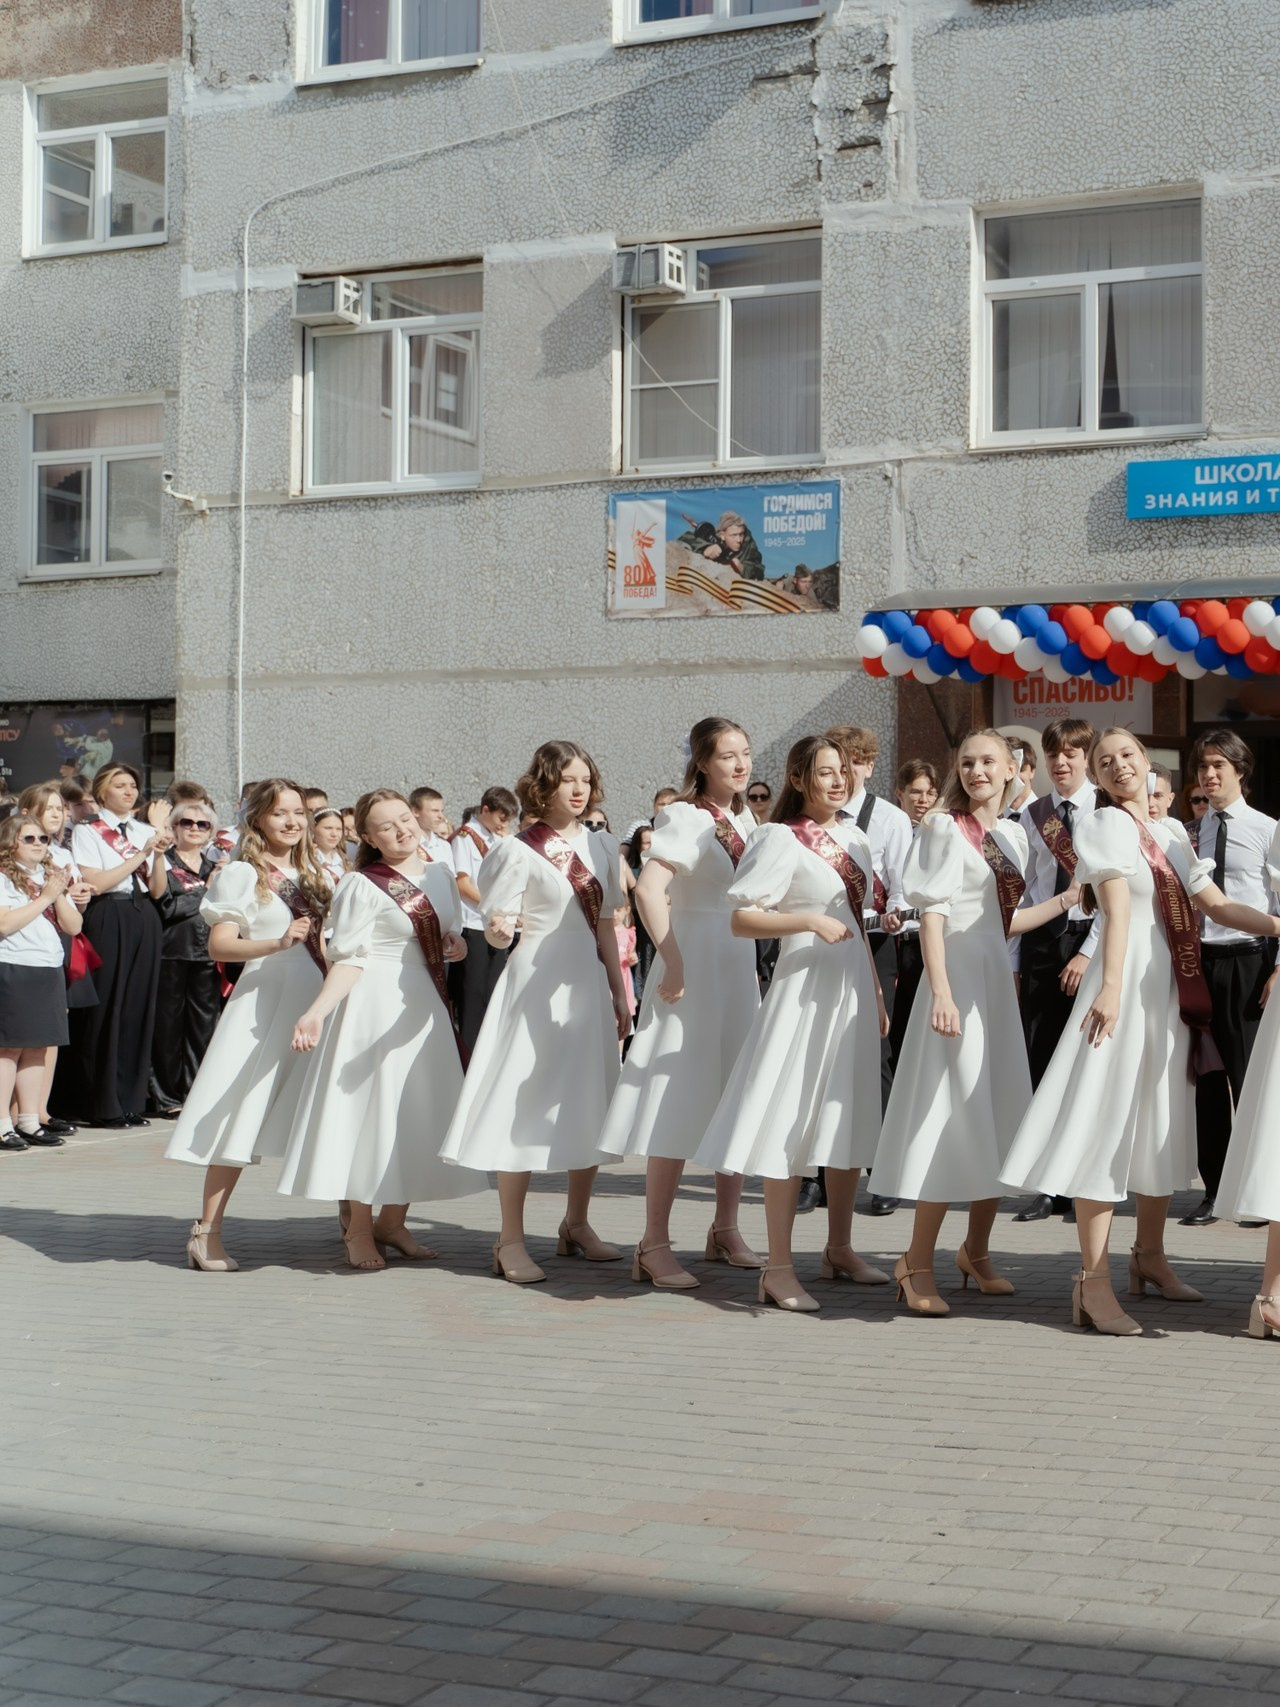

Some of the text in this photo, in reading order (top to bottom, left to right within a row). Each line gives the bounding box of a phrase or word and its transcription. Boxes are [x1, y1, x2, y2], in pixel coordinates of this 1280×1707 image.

[763, 493, 833, 514] ГОРДИМСЯ
[1144, 490, 1238, 510] ЗНАНИЯ
[1246, 490, 1260, 504] И
[763, 512, 826, 534] ПОБЕДОЙ!
[624, 565, 642, 585] 80
[623, 586, 657, 599] ПОБЕДА!
[1013, 675, 1134, 704] СПАСИБО!
[1177, 942, 1200, 978] 2025
